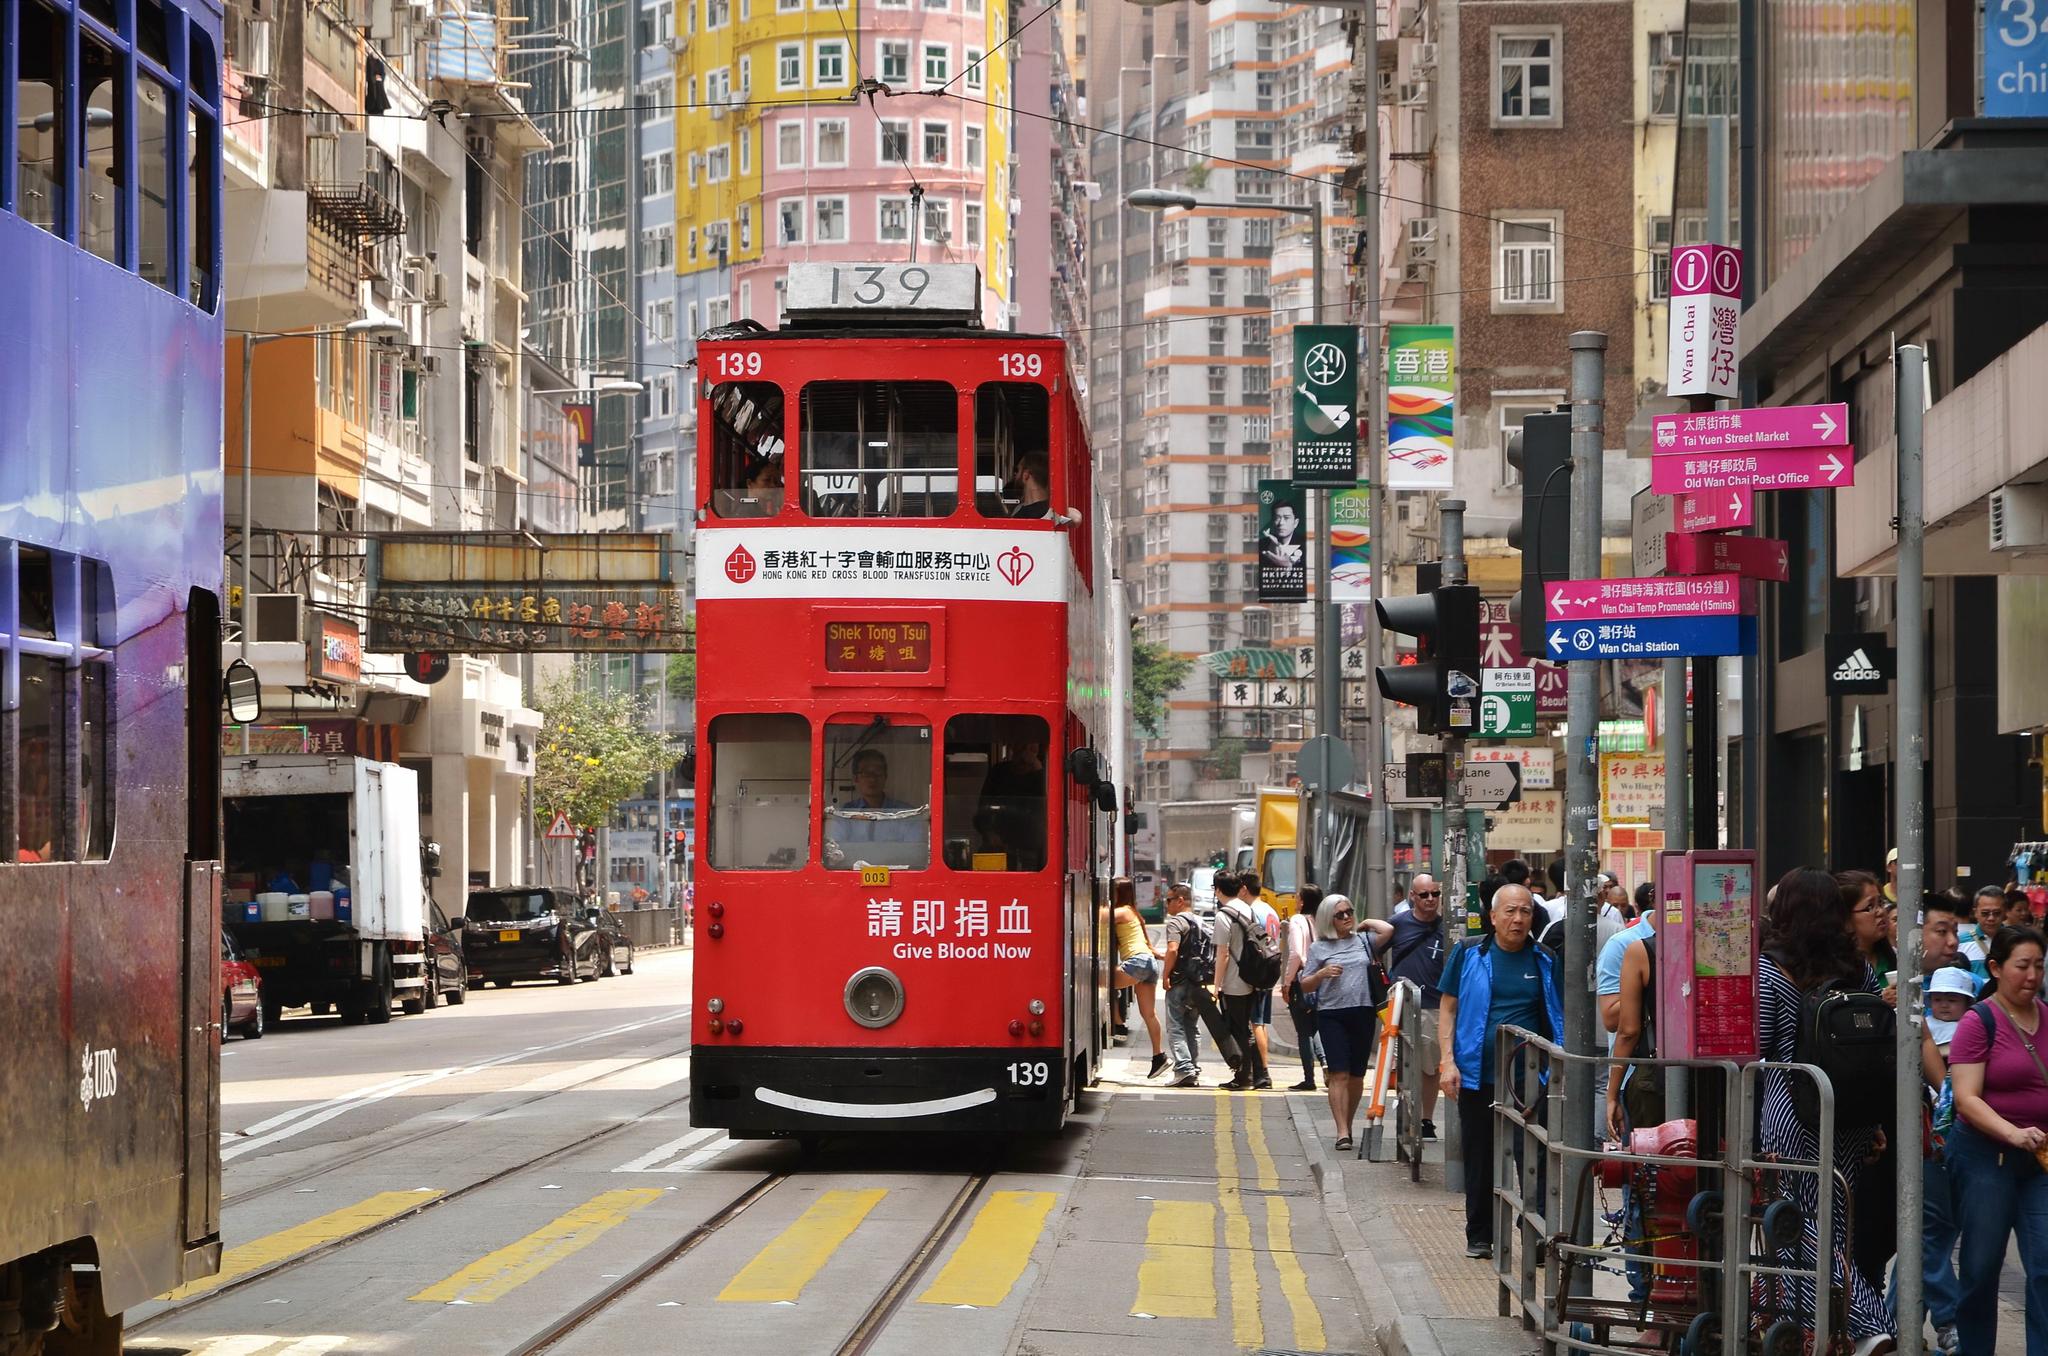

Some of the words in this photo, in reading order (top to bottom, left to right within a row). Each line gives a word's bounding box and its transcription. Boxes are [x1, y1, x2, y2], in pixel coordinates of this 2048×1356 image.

[2000, 0, 2048, 47] 3
[1998, 60, 2047, 94] chi
[831, 267, 930, 305] 139
[1683, 305, 1696, 343] Chai
[1711, 306, 1737, 386] 灣仔
[716, 352, 762, 376] 139
[998, 353, 1042, 377] 139
[1394, 349, 1449, 374] 香港
[1682, 349, 1694, 385] Wan
[1683, 415, 1742, 432] 太原街市集
[1683, 435, 1697, 447] Tai
[1699, 434, 1723, 446] Yuen
[1724, 432, 1753, 445] Street
[1755, 431, 1790, 443] Market
[1297, 447, 1352, 456] HKIFF42
[1684, 457, 1757, 476] 舊灣仔郵政局
[1684, 477, 1702, 489] Old
[1703, 476, 1726, 488] Wan
[1727, 475, 1750, 487] Chai
[1752, 473, 1776, 486] Post
[1778, 472, 1809, 484] Office
[1334, 497, 1370, 508] HON
[1334, 508, 1370, 518] KON
[763, 550, 990, 570] 香港紅十字會輸血服務中心
[762, 570, 782, 580] HONG
[786, 570, 807, 580] KONG
[812, 570, 827, 580] RED
[832, 570, 857, 580] CROSS
[862, 570, 889, 580] BLOOD
[894, 570, 950, 581] TRANSFUSION
[955, 571, 990, 582] SERVICE
[1601, 603, 1617, 615] Wan
[1618, 602, 1635, 614] Chai
[1637, 602, 1657, 614] Temp
[1658, 601, 1700, 612] Promenade
[1700, 599, 1736, 613] (15mins)
[830, 624, 862, 640] Shek
[867, 624, 897, 643] Tong
[901, 624, 927, 641] Tsui
[1599, 624, 1636, 640] 灣仔站
[839, 645, 917, 661] 石塘咀
[1599, 643, 1620, 654] Wan
[1621, 642, 1644, 653] Chai
[1645, 641, 1679, 652] Station
[1833, 669, 1880, 681] adidas
[1465, 768, 1491, 778] Lane
[864, 872, 886, 883] 003
[866, 898, 1032, 938] 請即捐血
[893, 943, 933, 959] Give
[937, 942, 988, 959] Blood
[993, 943, 1032, 959] Now
[94, 1047, 117, 1099] UBS
[1006, 1062, 1049, 1086] 139
